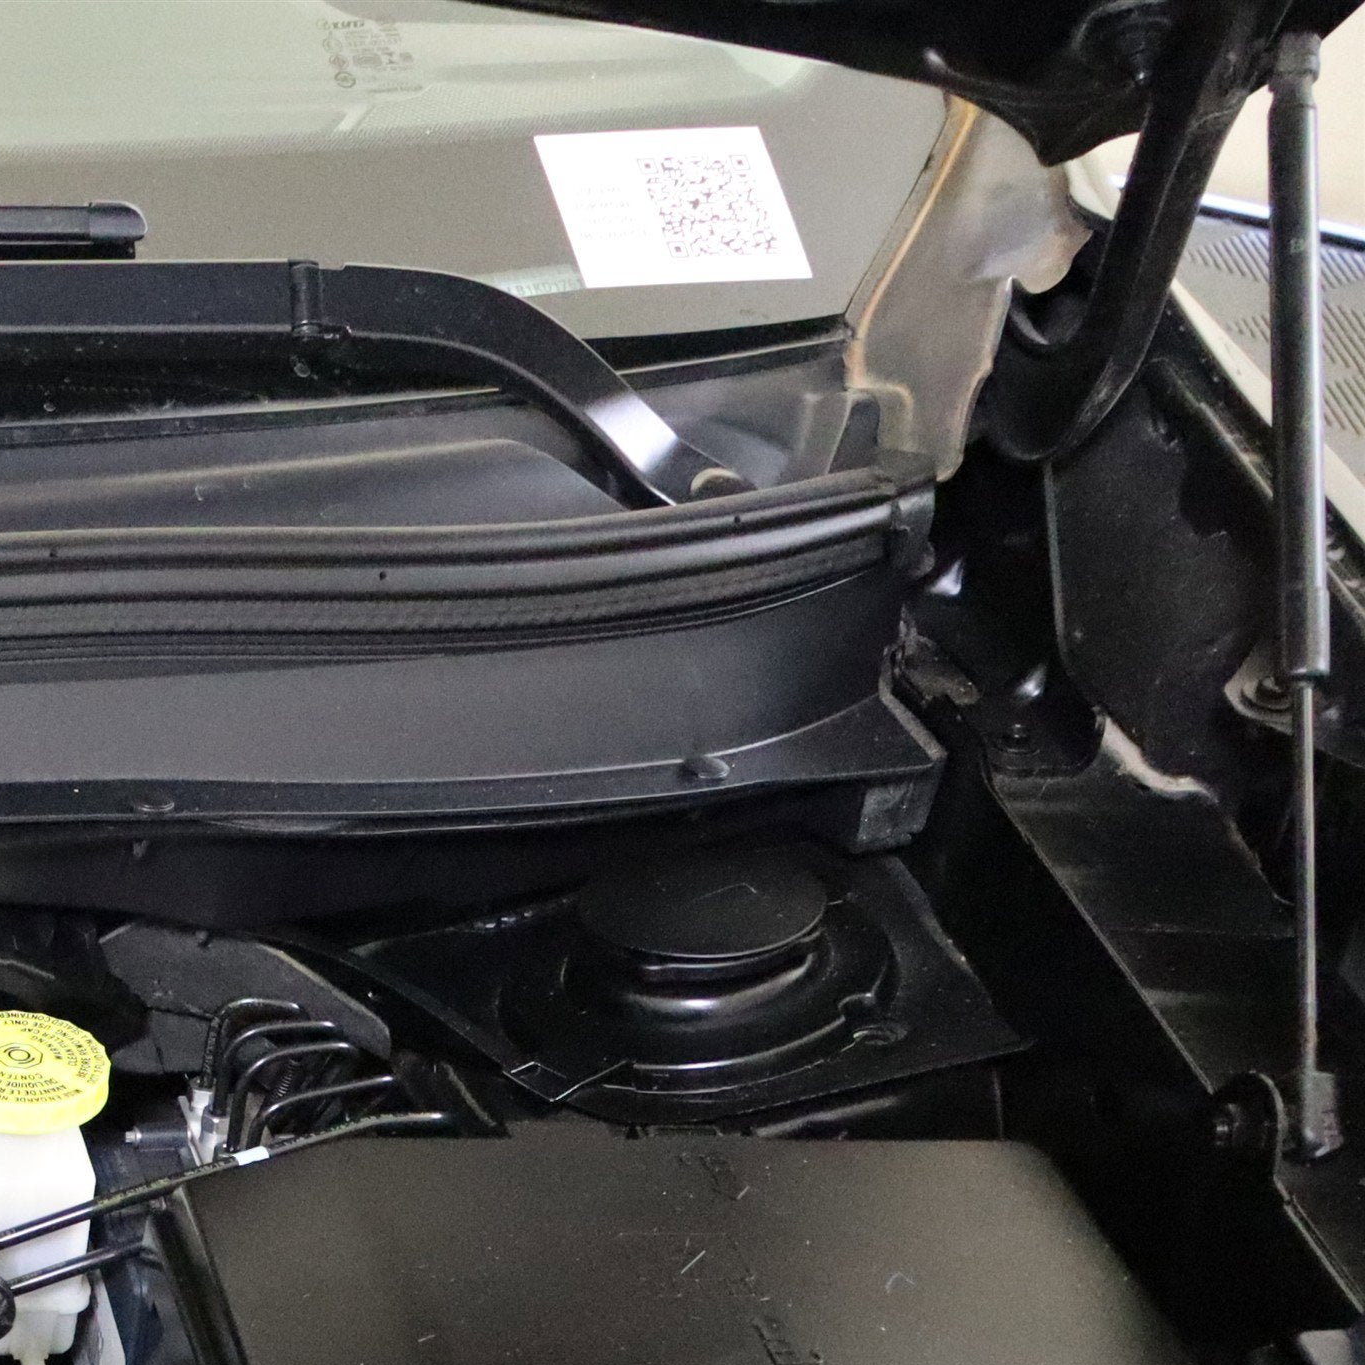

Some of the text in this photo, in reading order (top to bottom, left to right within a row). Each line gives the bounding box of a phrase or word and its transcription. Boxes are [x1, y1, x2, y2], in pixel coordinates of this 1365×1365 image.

[20, 1027, 41, 1035] CAP
[6, 1080, 45, 1088] LIQUIDE
[39, 1084, 68, 1096] AVANT
